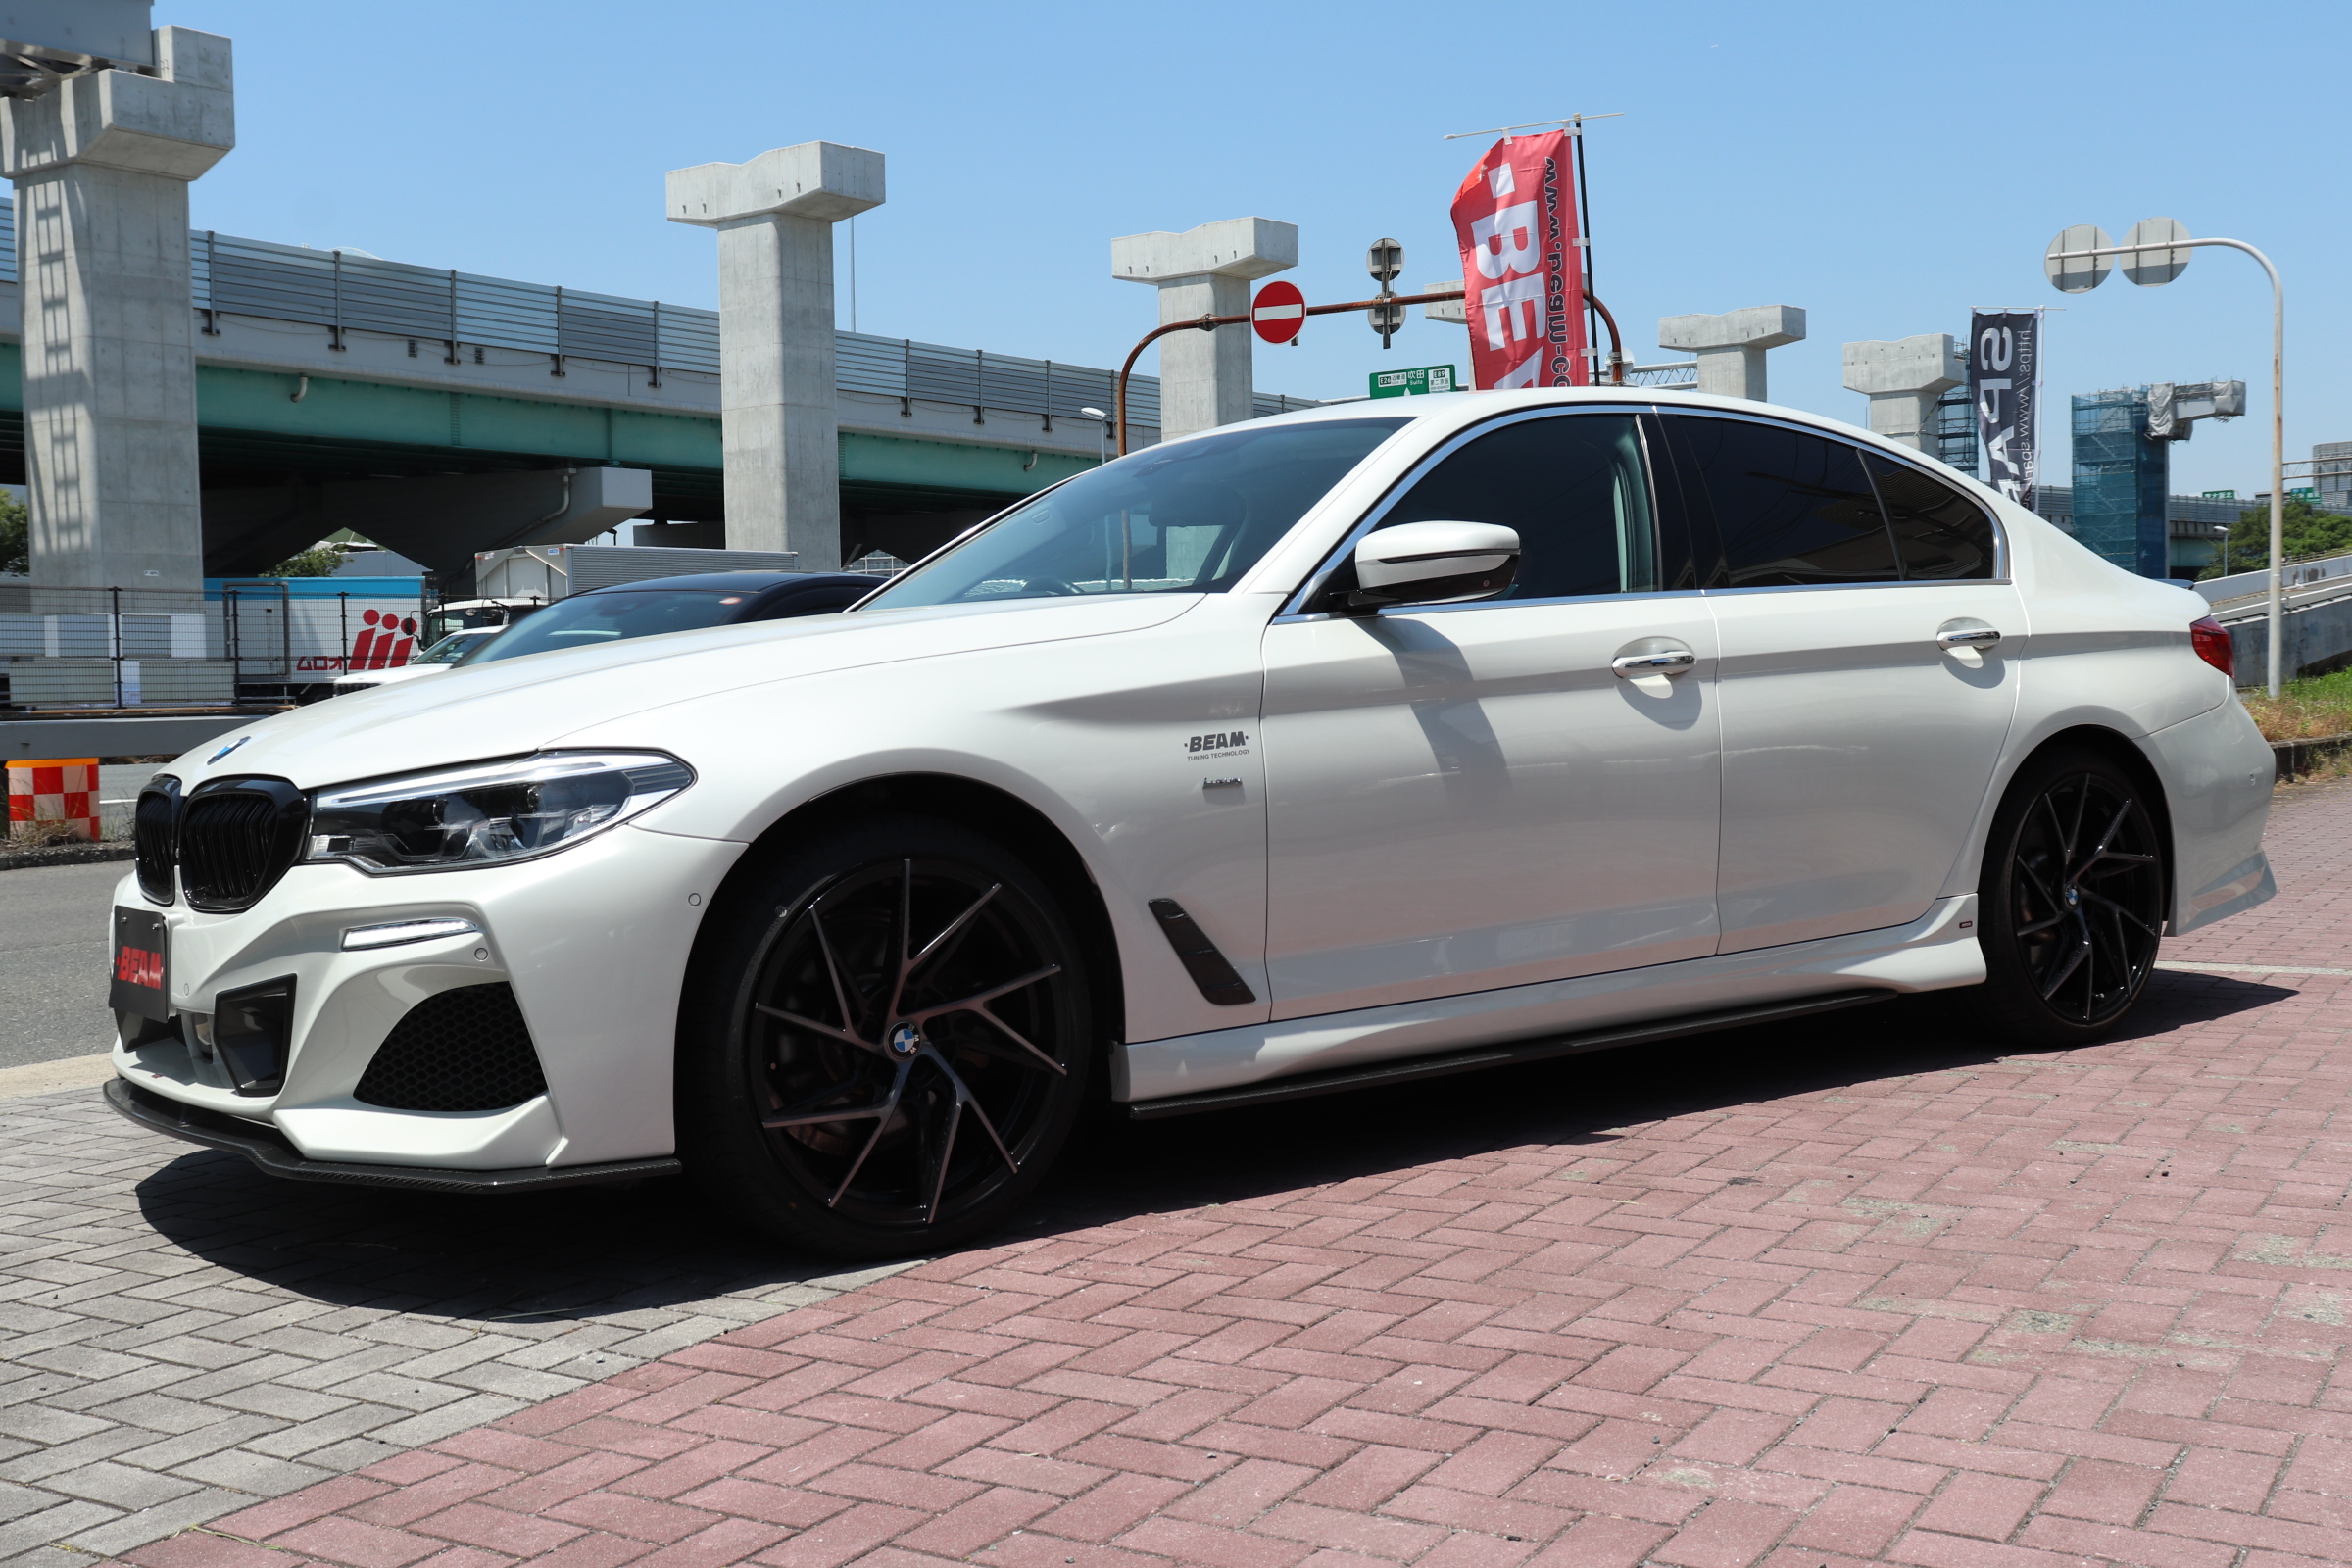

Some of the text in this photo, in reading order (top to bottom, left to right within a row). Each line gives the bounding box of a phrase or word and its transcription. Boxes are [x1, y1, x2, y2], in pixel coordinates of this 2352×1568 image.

[1408, 369, 1425, 379] 吹田
[1434, 369, 1446, 378] E89
[1211, 749, 1250, 759] TECHNOLOGY
